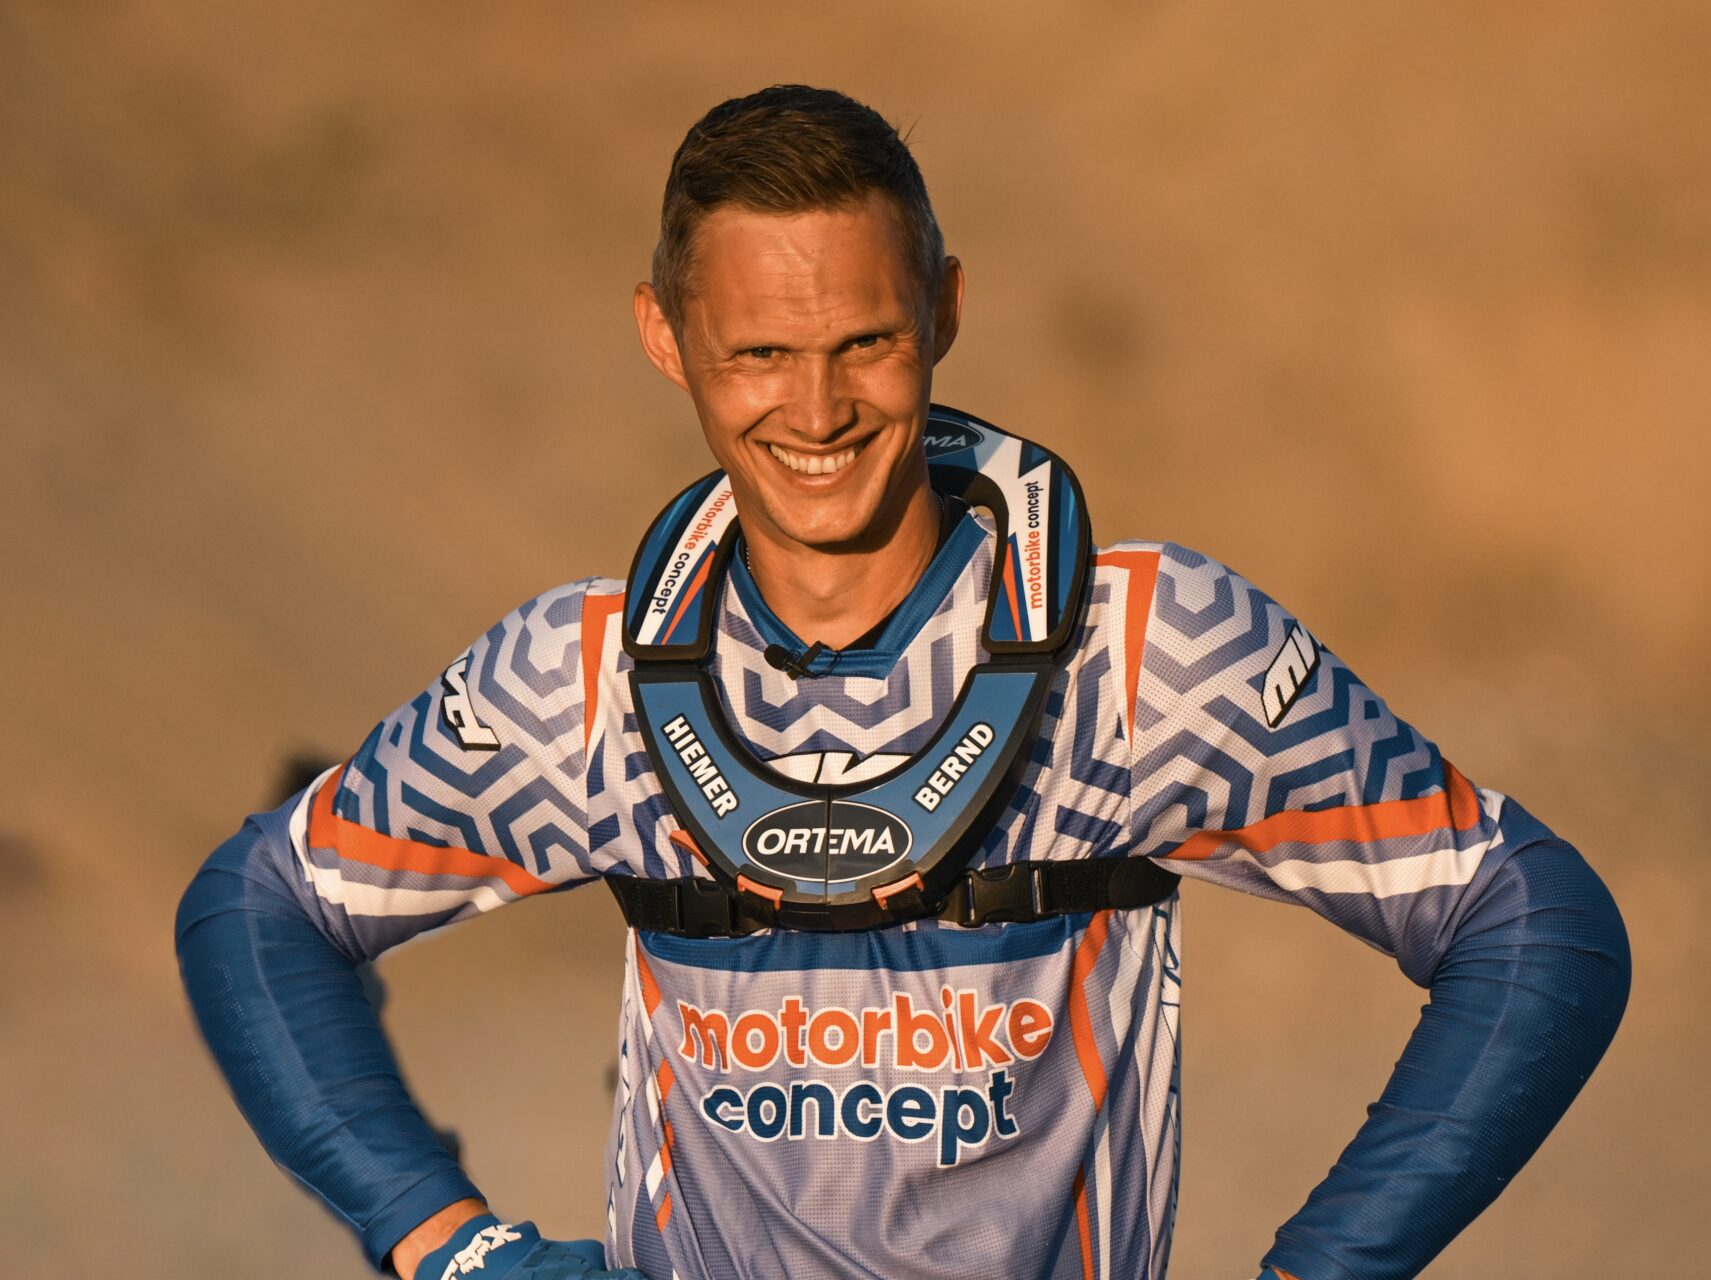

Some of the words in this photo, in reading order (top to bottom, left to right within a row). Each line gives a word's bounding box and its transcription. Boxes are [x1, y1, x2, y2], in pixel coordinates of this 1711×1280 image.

[684, 490, 733, 550] motorbike
[1024, 480, 1044, 529] concept
[652, 552, 691, 615] concept
[1024, 530, 1043, 610] motorbike
[662, 714, 739, 818] HIEMER
[914, 723, 995, 812] BERND
[756, 825, 896, 856] ORTEMA
[677, 984, 1054, 1073] motorbike
[702, 1066, 1020, 1168] concept
